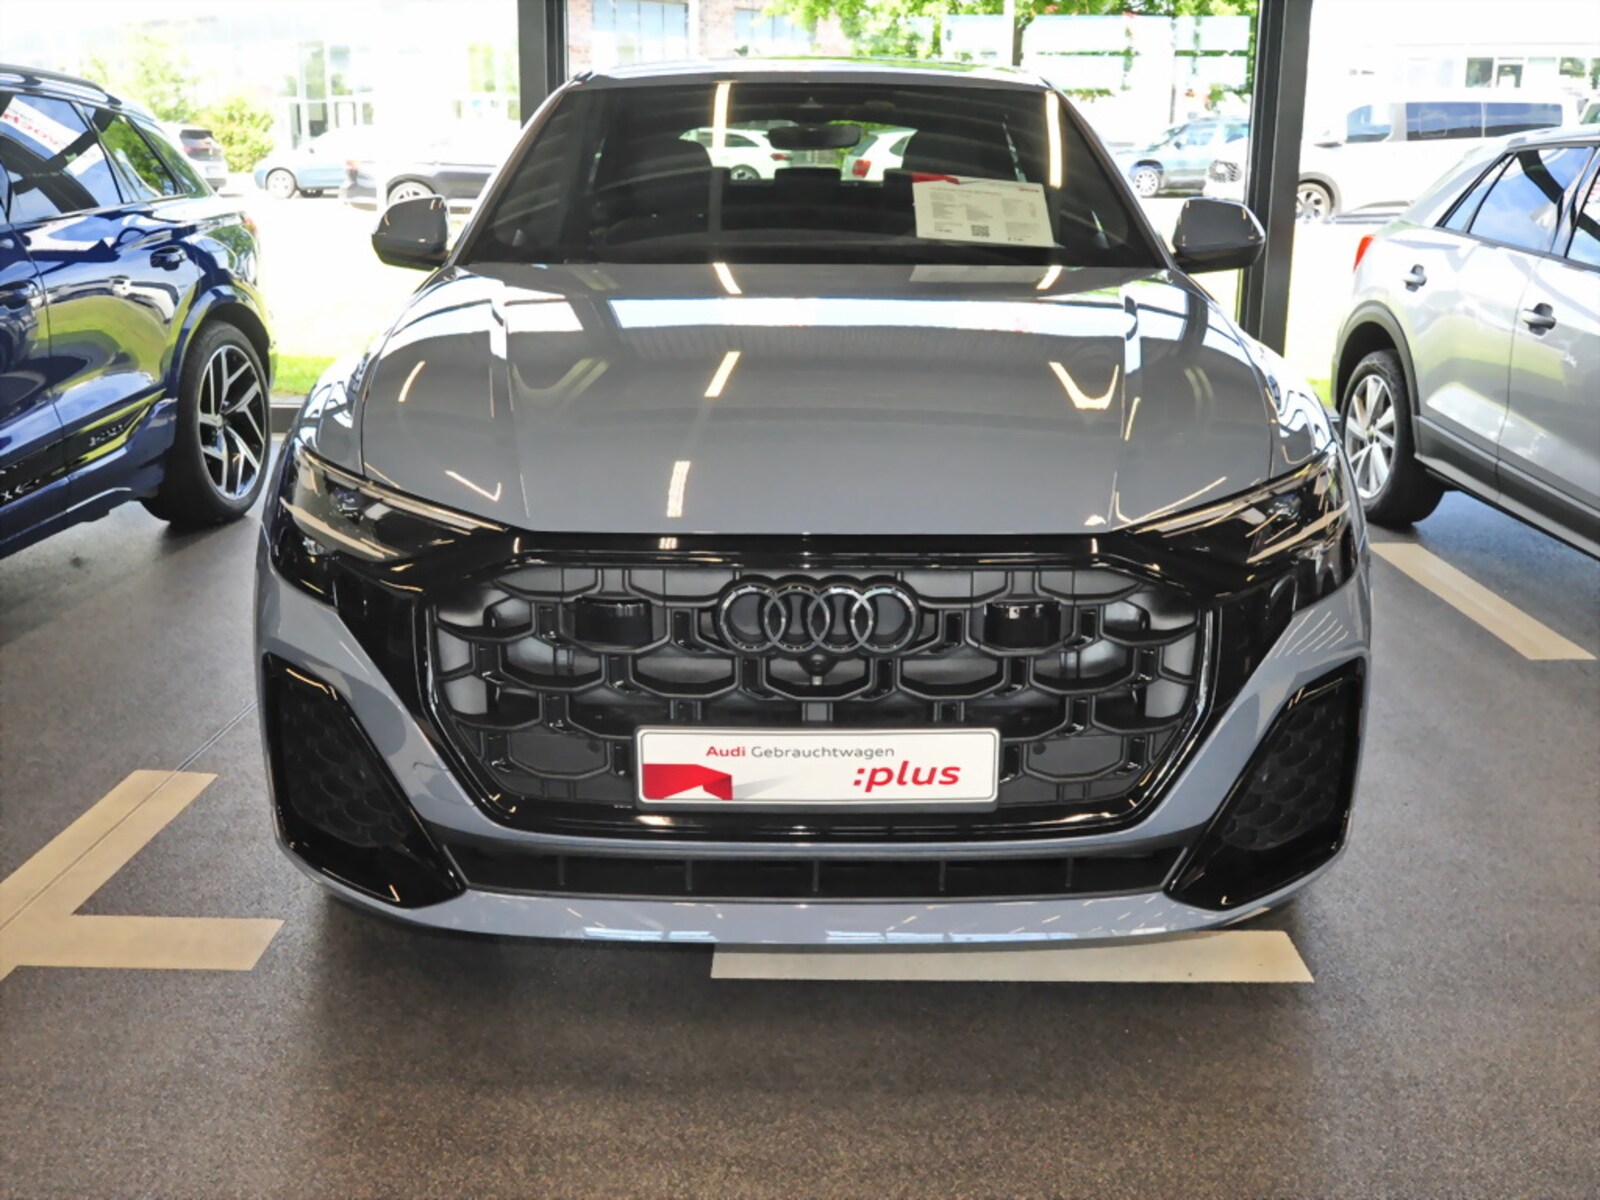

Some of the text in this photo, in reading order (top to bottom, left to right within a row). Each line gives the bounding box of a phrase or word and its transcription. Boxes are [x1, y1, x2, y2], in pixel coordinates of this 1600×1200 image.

[705, 745, 895, 760] Audi Gebrauchtwagen
[853, 760, 962, 793] :plus
